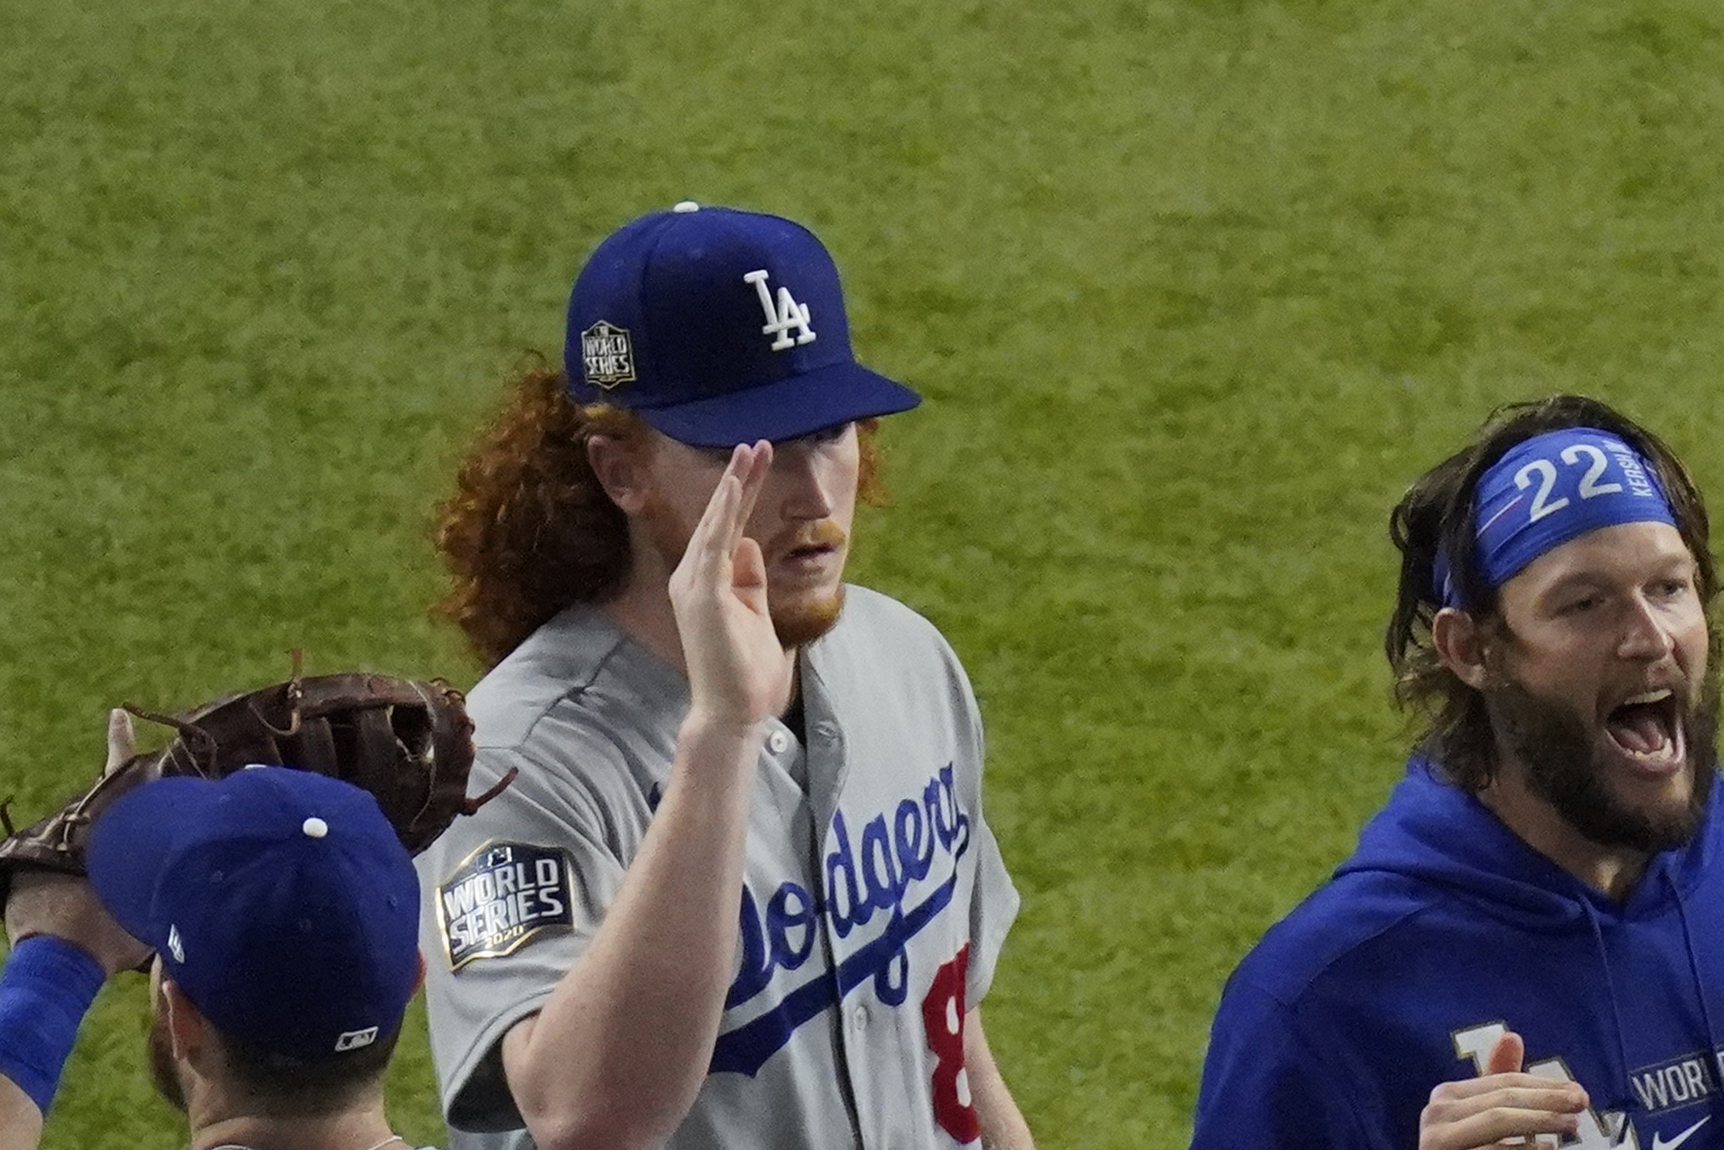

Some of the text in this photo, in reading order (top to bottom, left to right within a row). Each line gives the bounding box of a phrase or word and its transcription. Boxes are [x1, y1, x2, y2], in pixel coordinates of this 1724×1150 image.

[744, 269, 817, 351] LA
[585, 354, 630, 375] SERIES
[1514, 444, 1623, 522] 22
[444, 859, 559, 919] WORLD
[450, 887, 563, 954] SERIES
[485, 925, 524, 949] 2020
